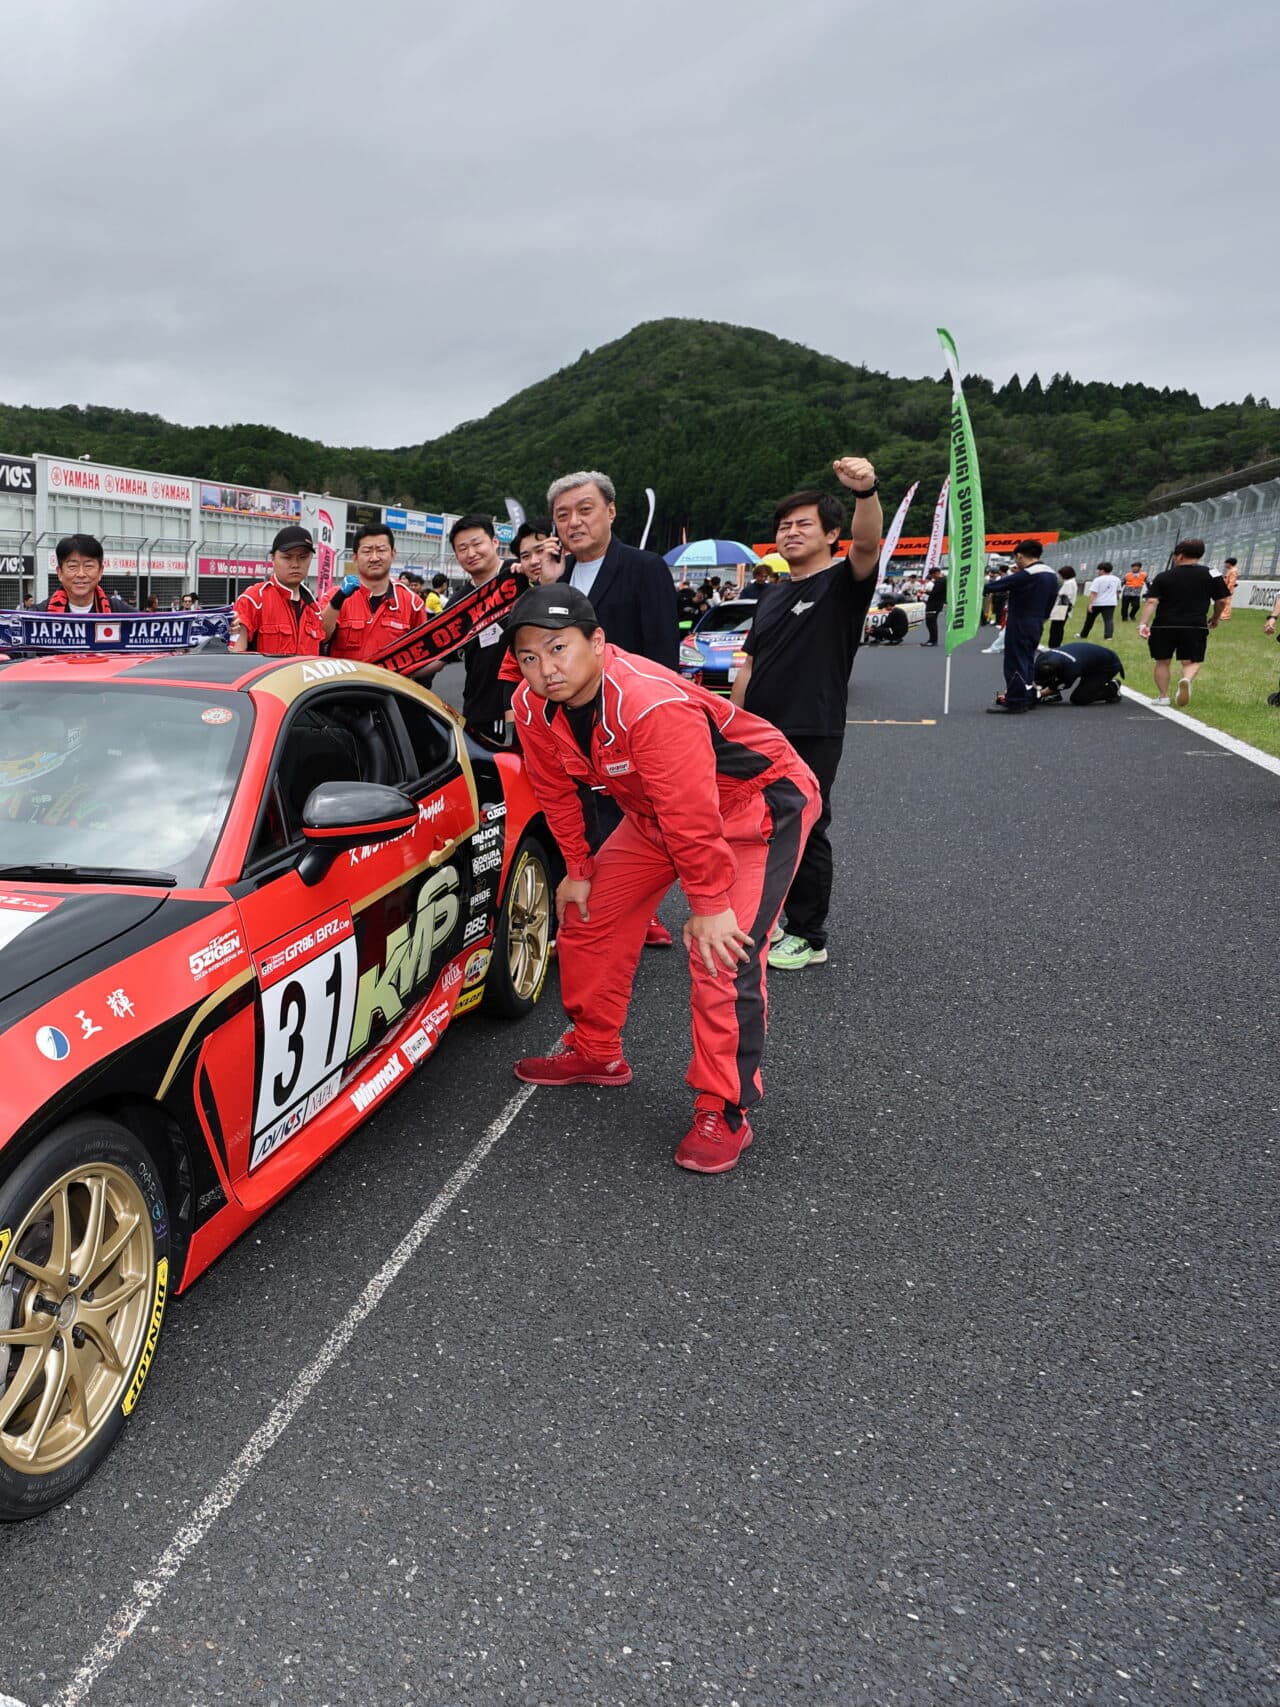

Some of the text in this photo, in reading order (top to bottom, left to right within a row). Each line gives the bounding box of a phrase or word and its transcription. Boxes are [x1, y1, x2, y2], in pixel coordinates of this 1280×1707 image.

[63, 469, 190, 501] YAMAHA YAMAHA YAMAHA
[951, 406, 974, 631] TOCHIGI SUBARU Racing
[217, 562, 247, 573] Welcome
[431, 618, 464, 648] OF
[467, 578, 518, 624] KMS
[31, 622, 87, 638] JAPAN
[129, 621, 185, 637] JAPAN
[129, 637, 163, 645] NATIONAL
[486, 804, 508, 820] CUSCO
[471, 825, 500, 846] BILLION
[470, 887, 491, 906] BRIDE
[285, 917, 340, 962] GR86/BRZ
[463, 913, 488, 940] BBS
[188, 935, 241, 976] 5ZIGEN
[348, 864, 460, 1060] KMS
[273, 951, 342, 1108] 31
[129, 1283, 166, 1402] DUNLOP
